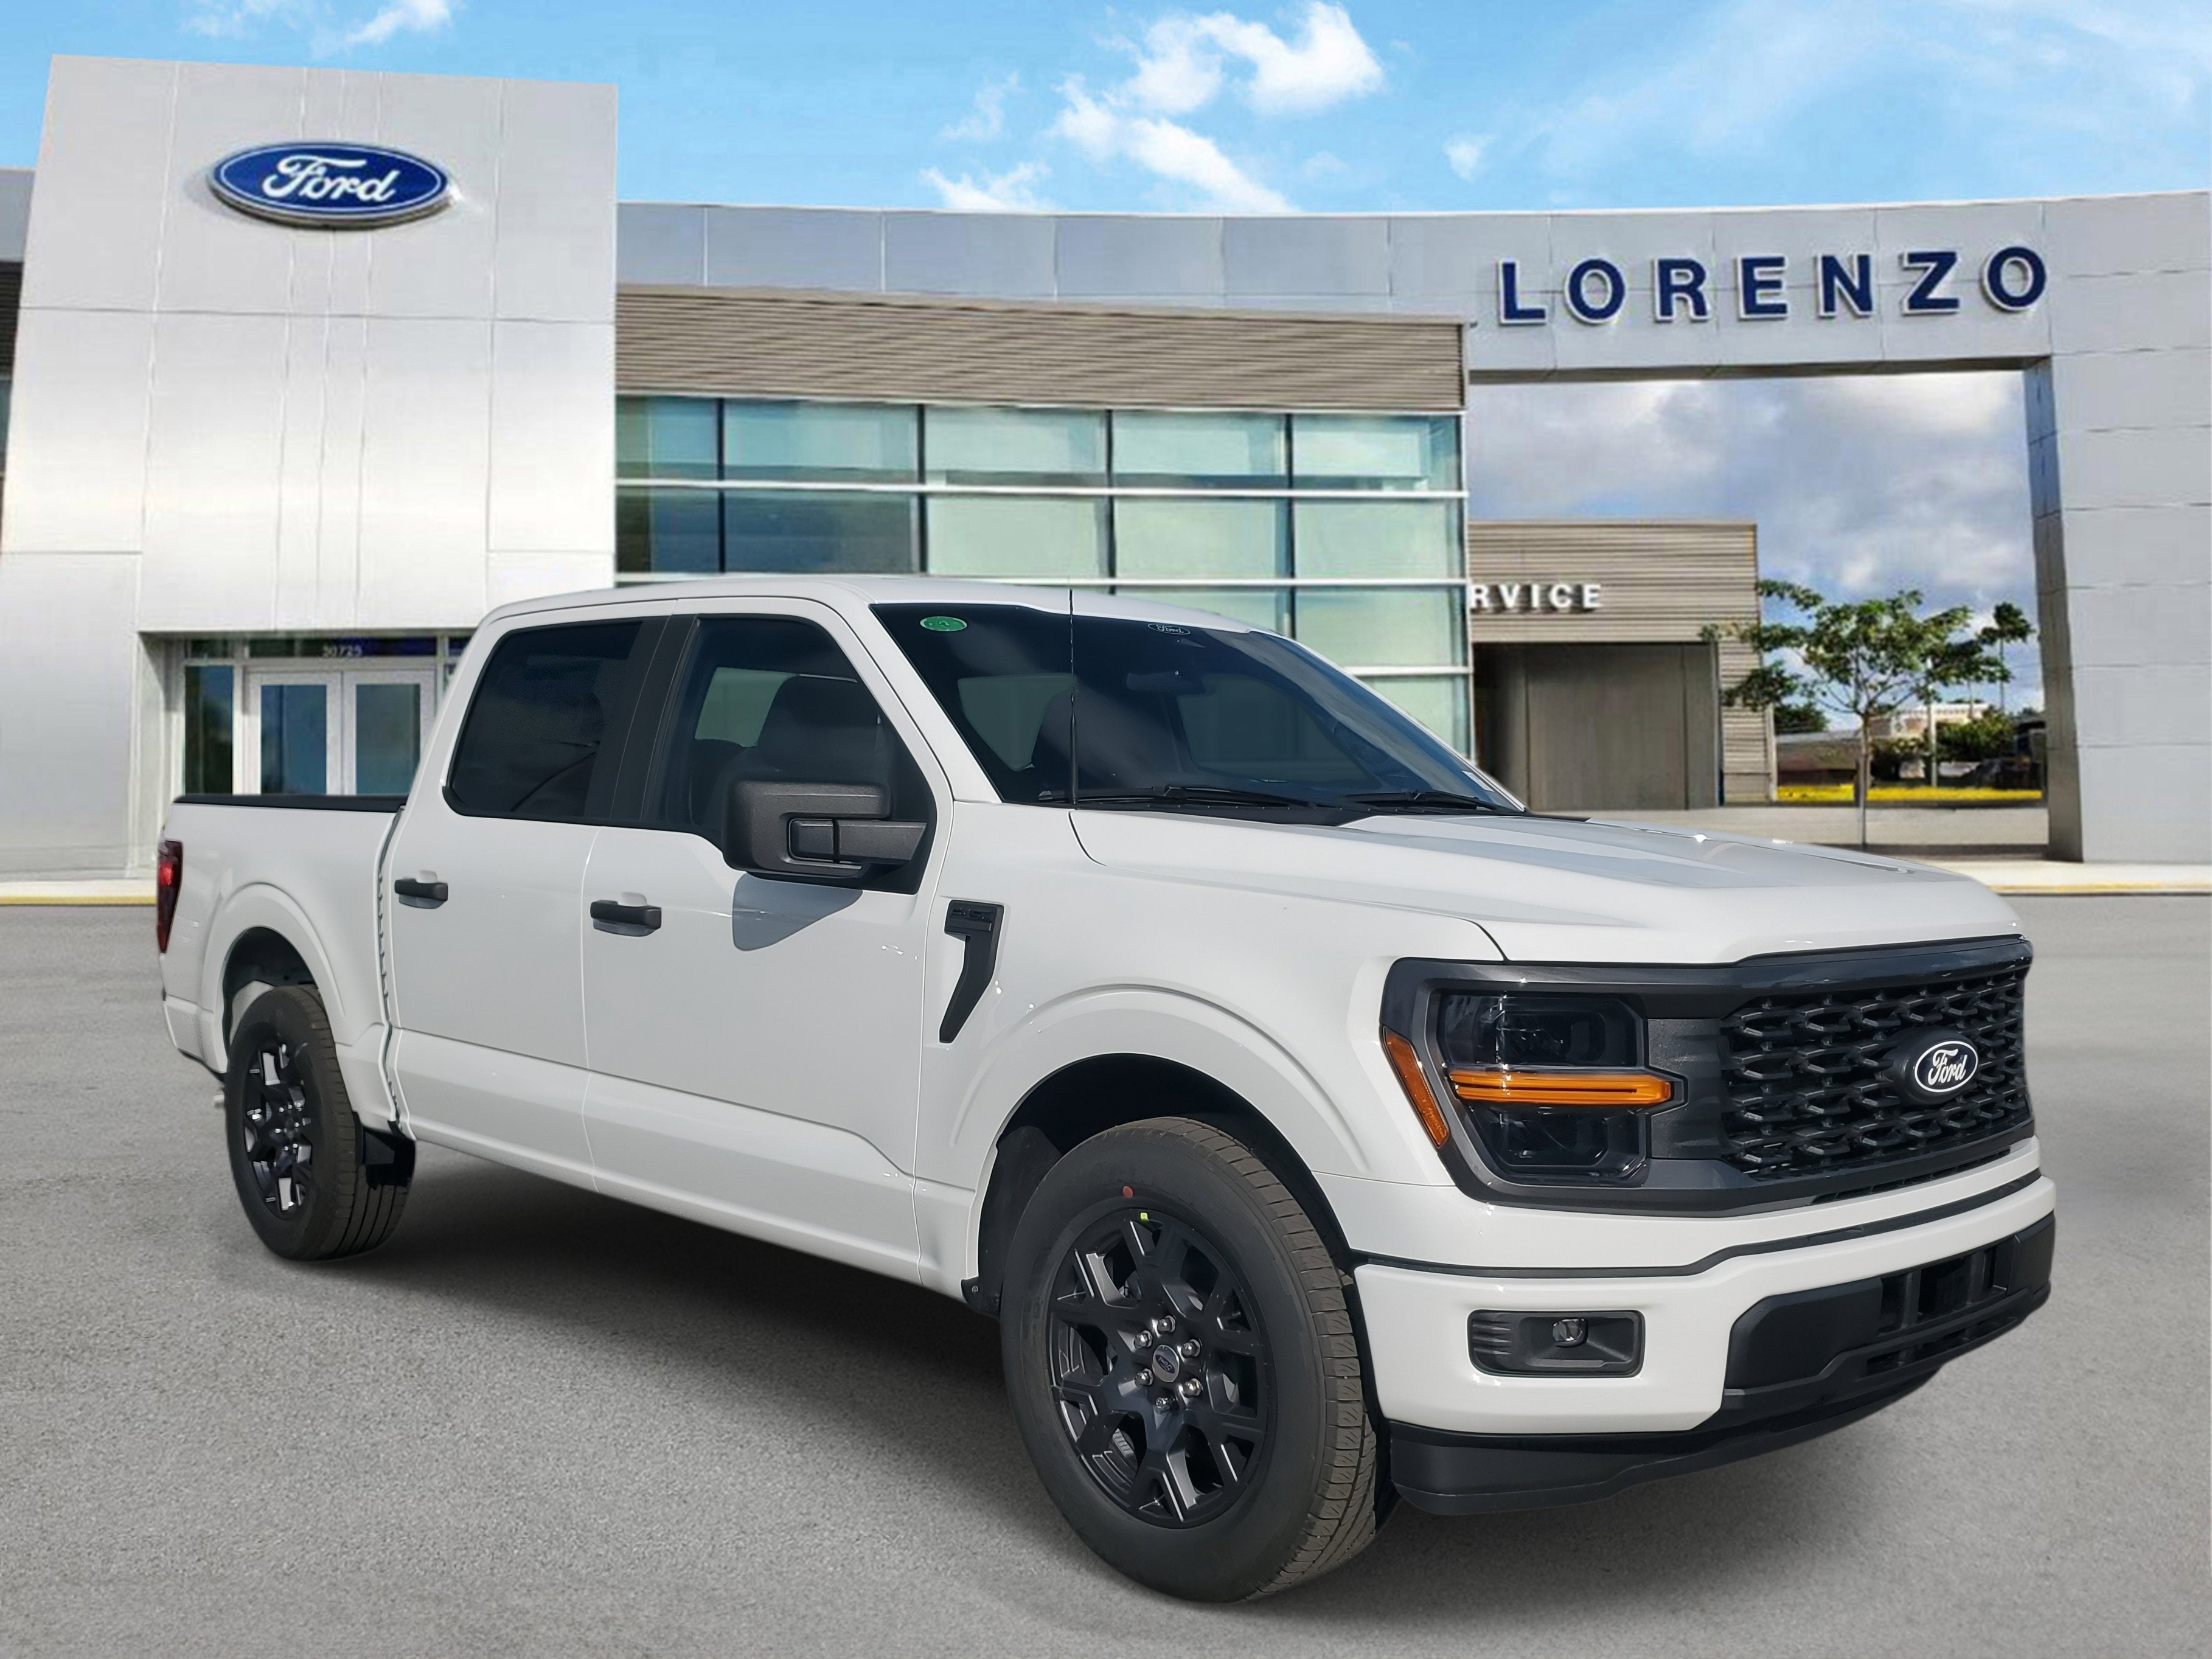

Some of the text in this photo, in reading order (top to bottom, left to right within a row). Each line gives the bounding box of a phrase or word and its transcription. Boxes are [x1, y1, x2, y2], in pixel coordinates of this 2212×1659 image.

[262, 155, 400, 201] Ford
[1498, 246, 2047, 323] LORENZO
[1470, 584, 1601, 608] RVICE
[1928, 1049, 1967, 1085] Ford
